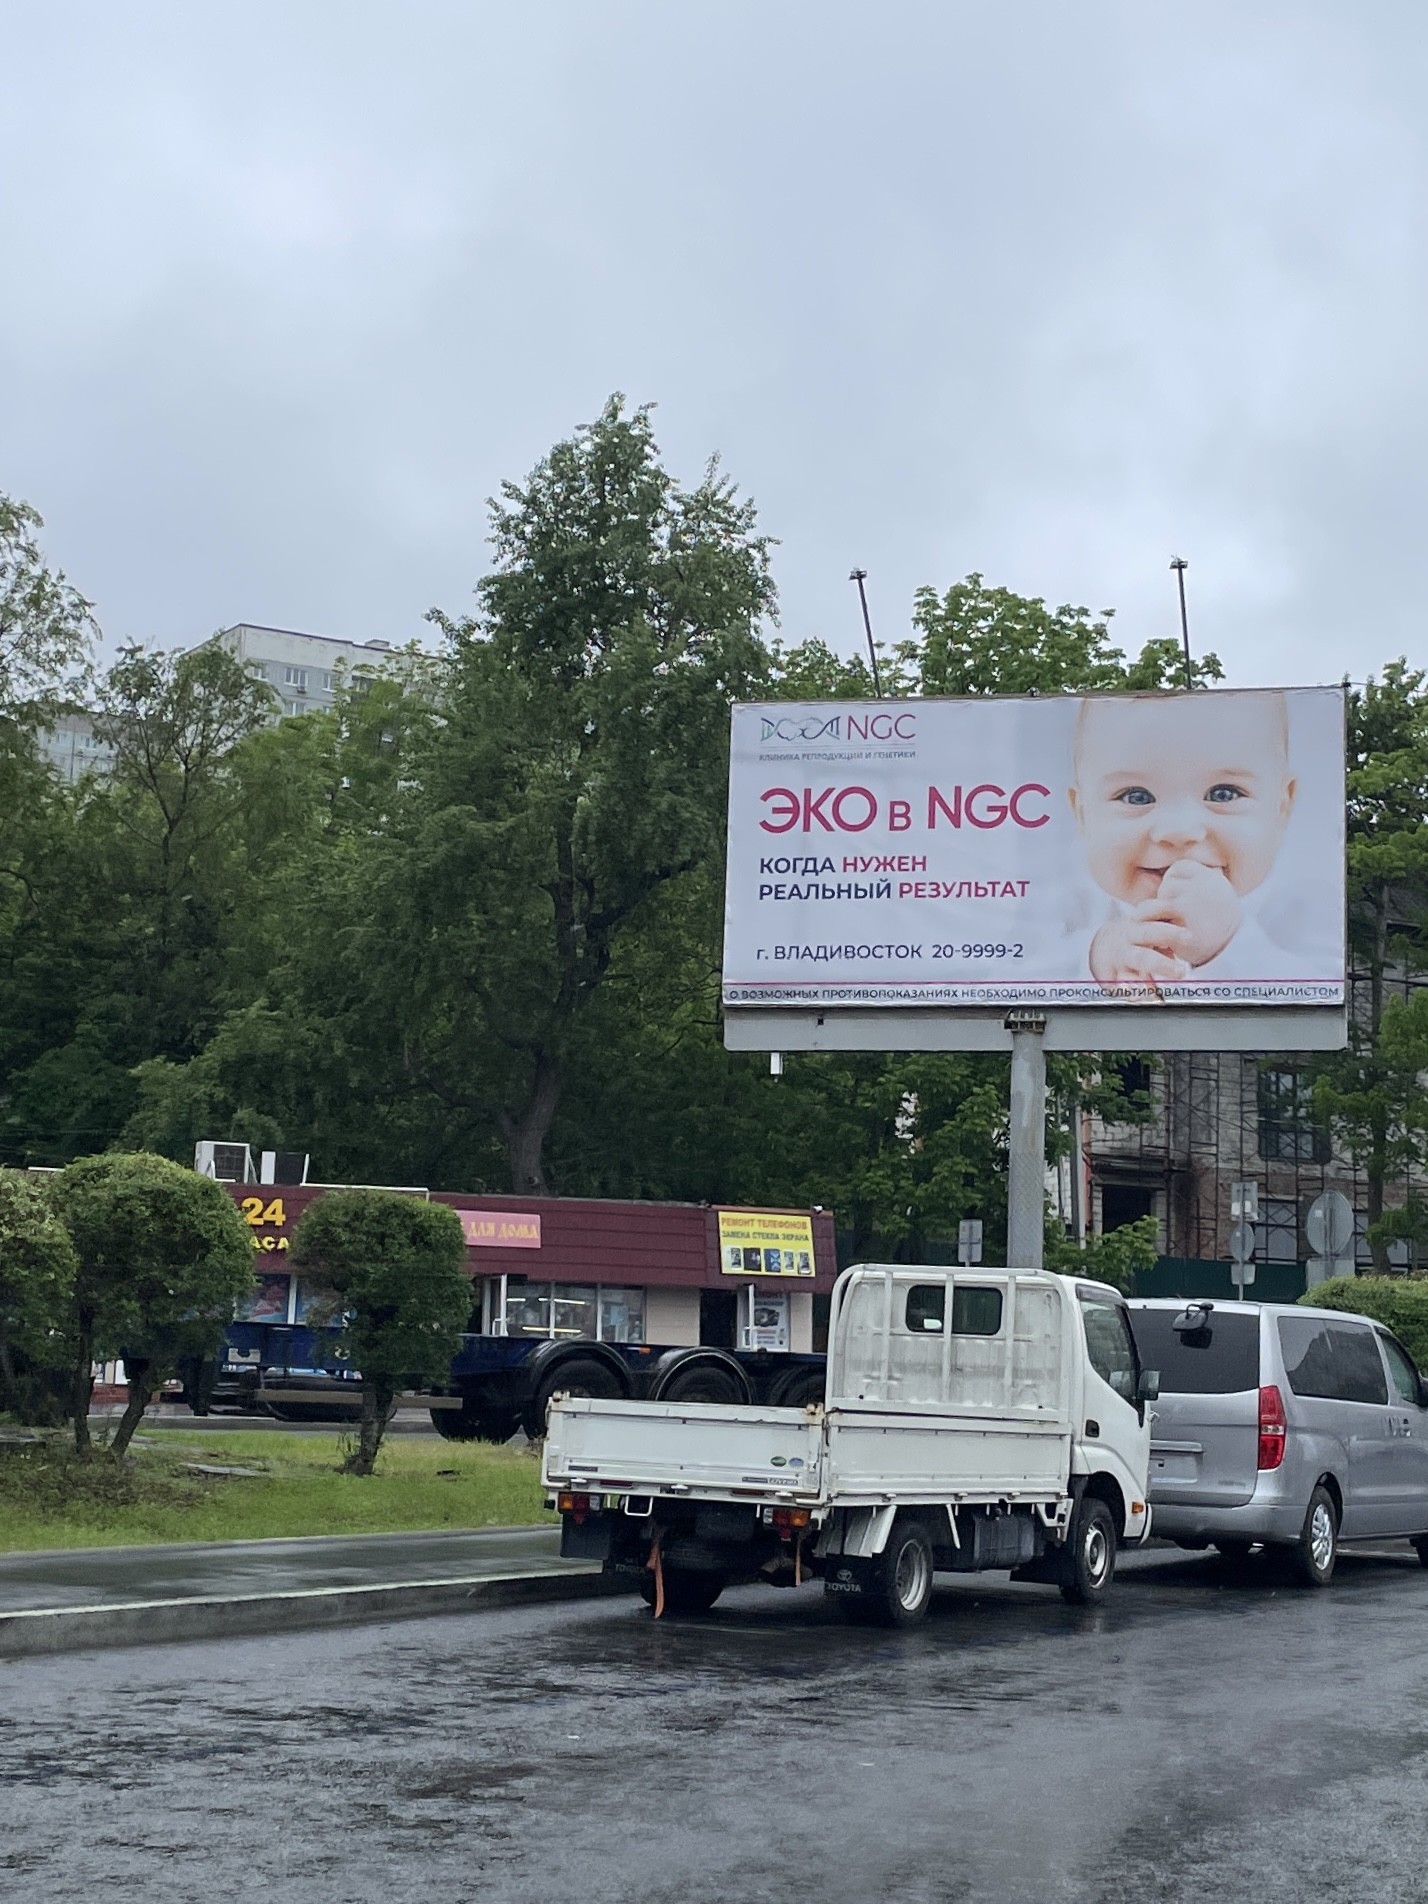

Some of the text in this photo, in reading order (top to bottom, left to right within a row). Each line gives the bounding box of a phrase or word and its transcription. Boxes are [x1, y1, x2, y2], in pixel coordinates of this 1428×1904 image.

[847, 714, 917, 740] NGC
[759, 751, 916, 762] КЛИНИКА РЕПРОДУКЦИИ И ГЕНЕТИКИ
[759, 786, 878, 834] ЭКО
[927, 783, 1051, 830] NGC
[759, 855, 928, 877] КОГДА НУЖЕН
[759, 878, 1031, 901] РЕАЛЬНЫЙ РЕЗУЛЬТАТ
[773, 944, 923, 963] ВЛАДИВОСТОК
[931, 943, 1024, 959] 20-9999-2
[730, 986, 1339, 1001] О ВОЗМОЖНЫХ ПРОТИВОПОКАЗАНИЯХ НЕОБХОДИМО ПРОКОНСУЛЬТИРОВАТЬСЯ СО СПЕЦИАЛИСТОМ
[241, 1197, 286, 1226] 24
[721, 1217, 808, 1230] РЕМОНТ ТЕЛЕФОНОВ
[250, 1236, 290, 1251] АСА
